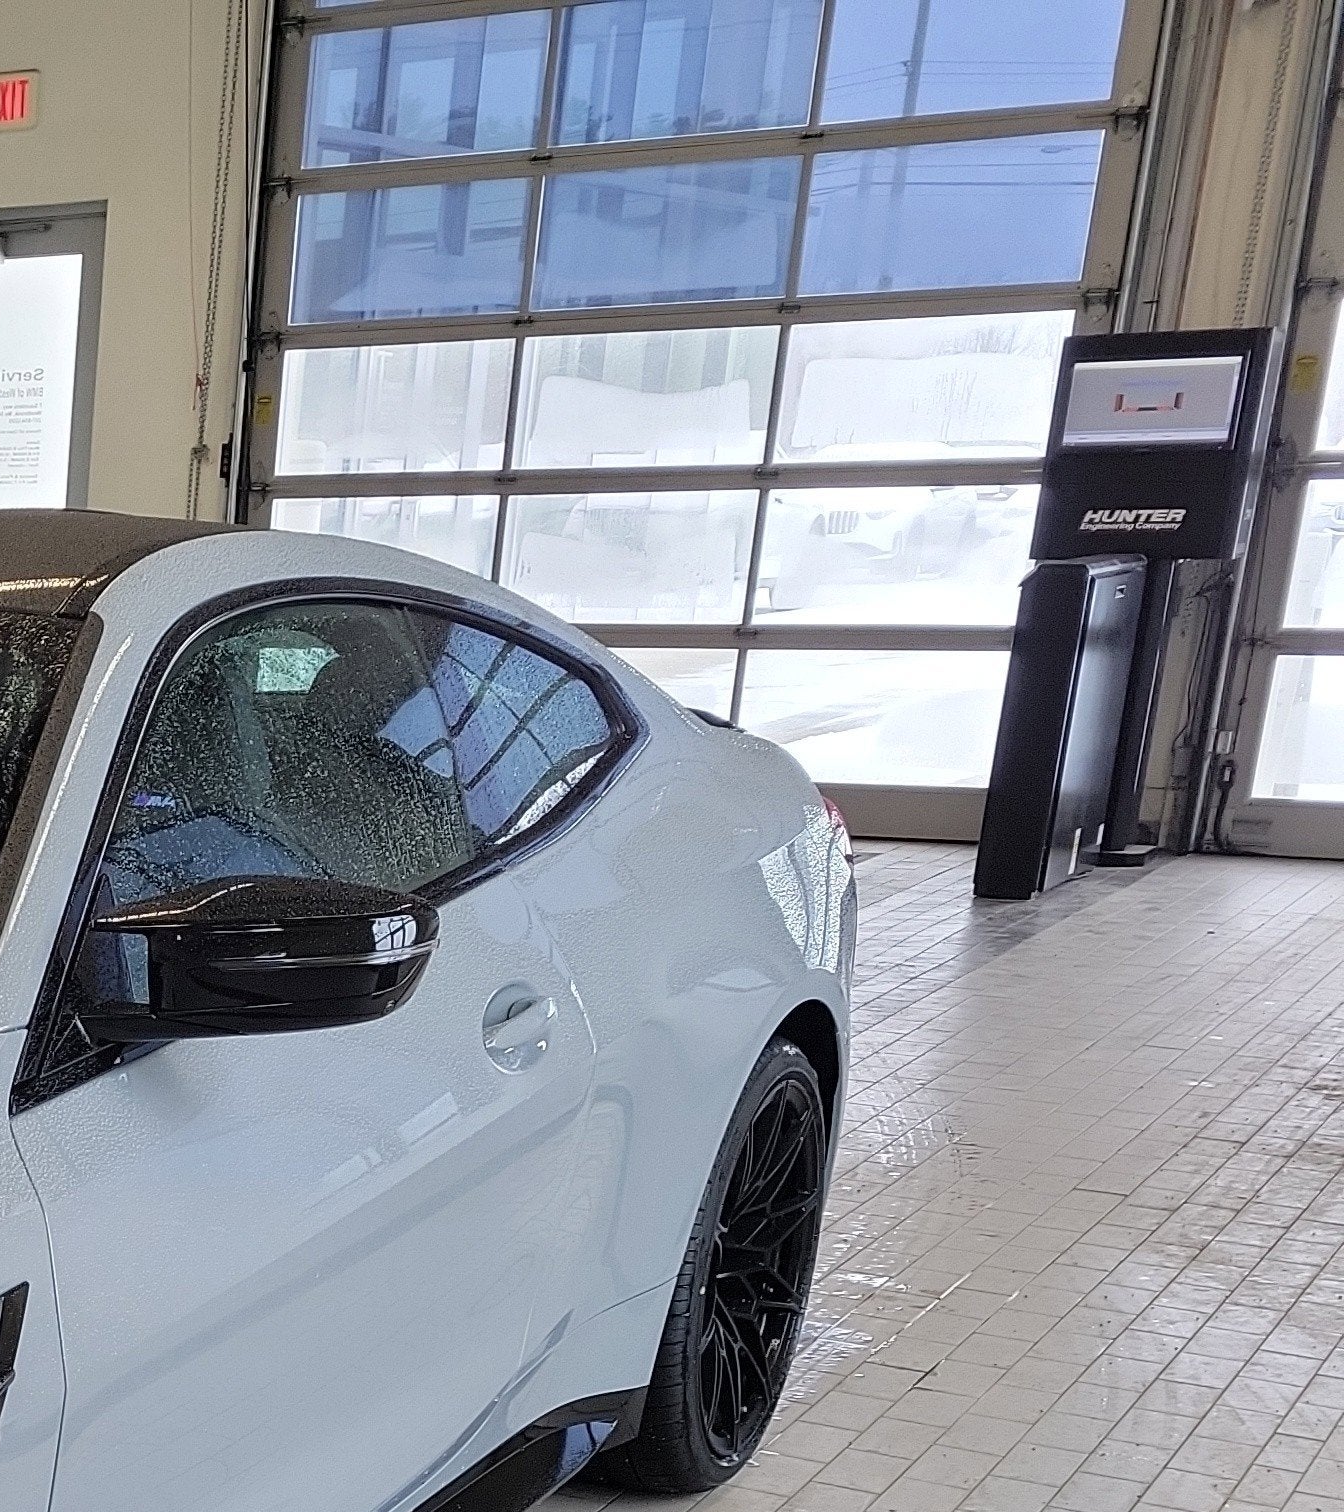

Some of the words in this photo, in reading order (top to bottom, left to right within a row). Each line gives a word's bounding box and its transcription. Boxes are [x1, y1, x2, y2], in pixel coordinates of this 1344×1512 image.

[1082, 508, 1187, 523] HUNTER
[1079, 522, 1134, 533] Engineering
[1135, 522, 1182, 532] Company
